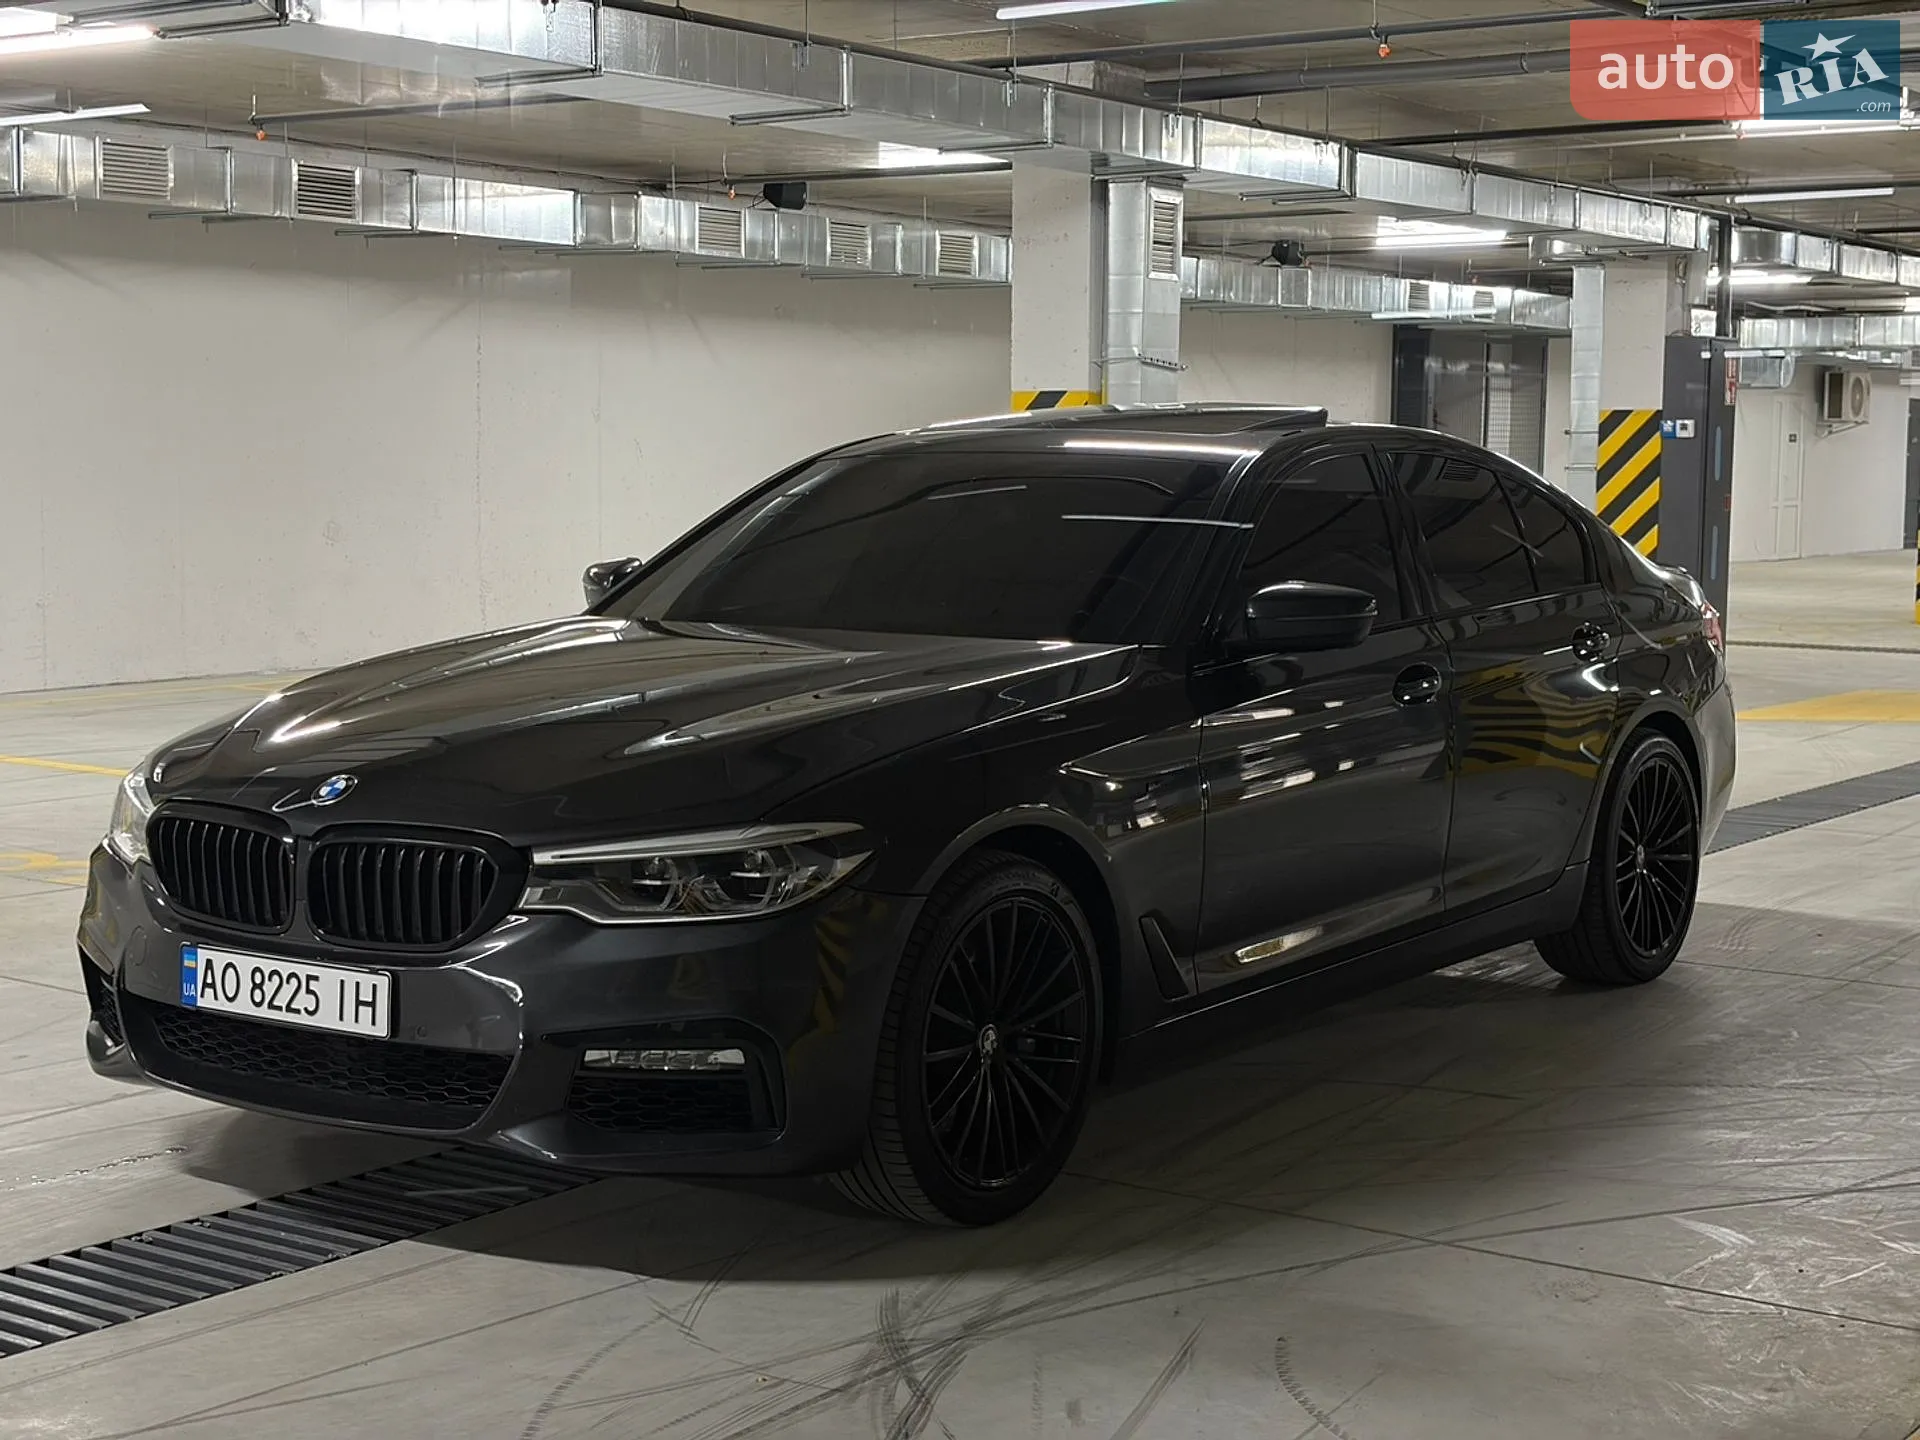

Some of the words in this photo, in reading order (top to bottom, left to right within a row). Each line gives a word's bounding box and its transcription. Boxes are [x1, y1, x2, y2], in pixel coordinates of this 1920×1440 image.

[183, 982, 196, 997] UA
[200, 958, 241, 1003] AO
[250, 966, 320, 1017] 8225
[338, 978, 378, 1027] IH
